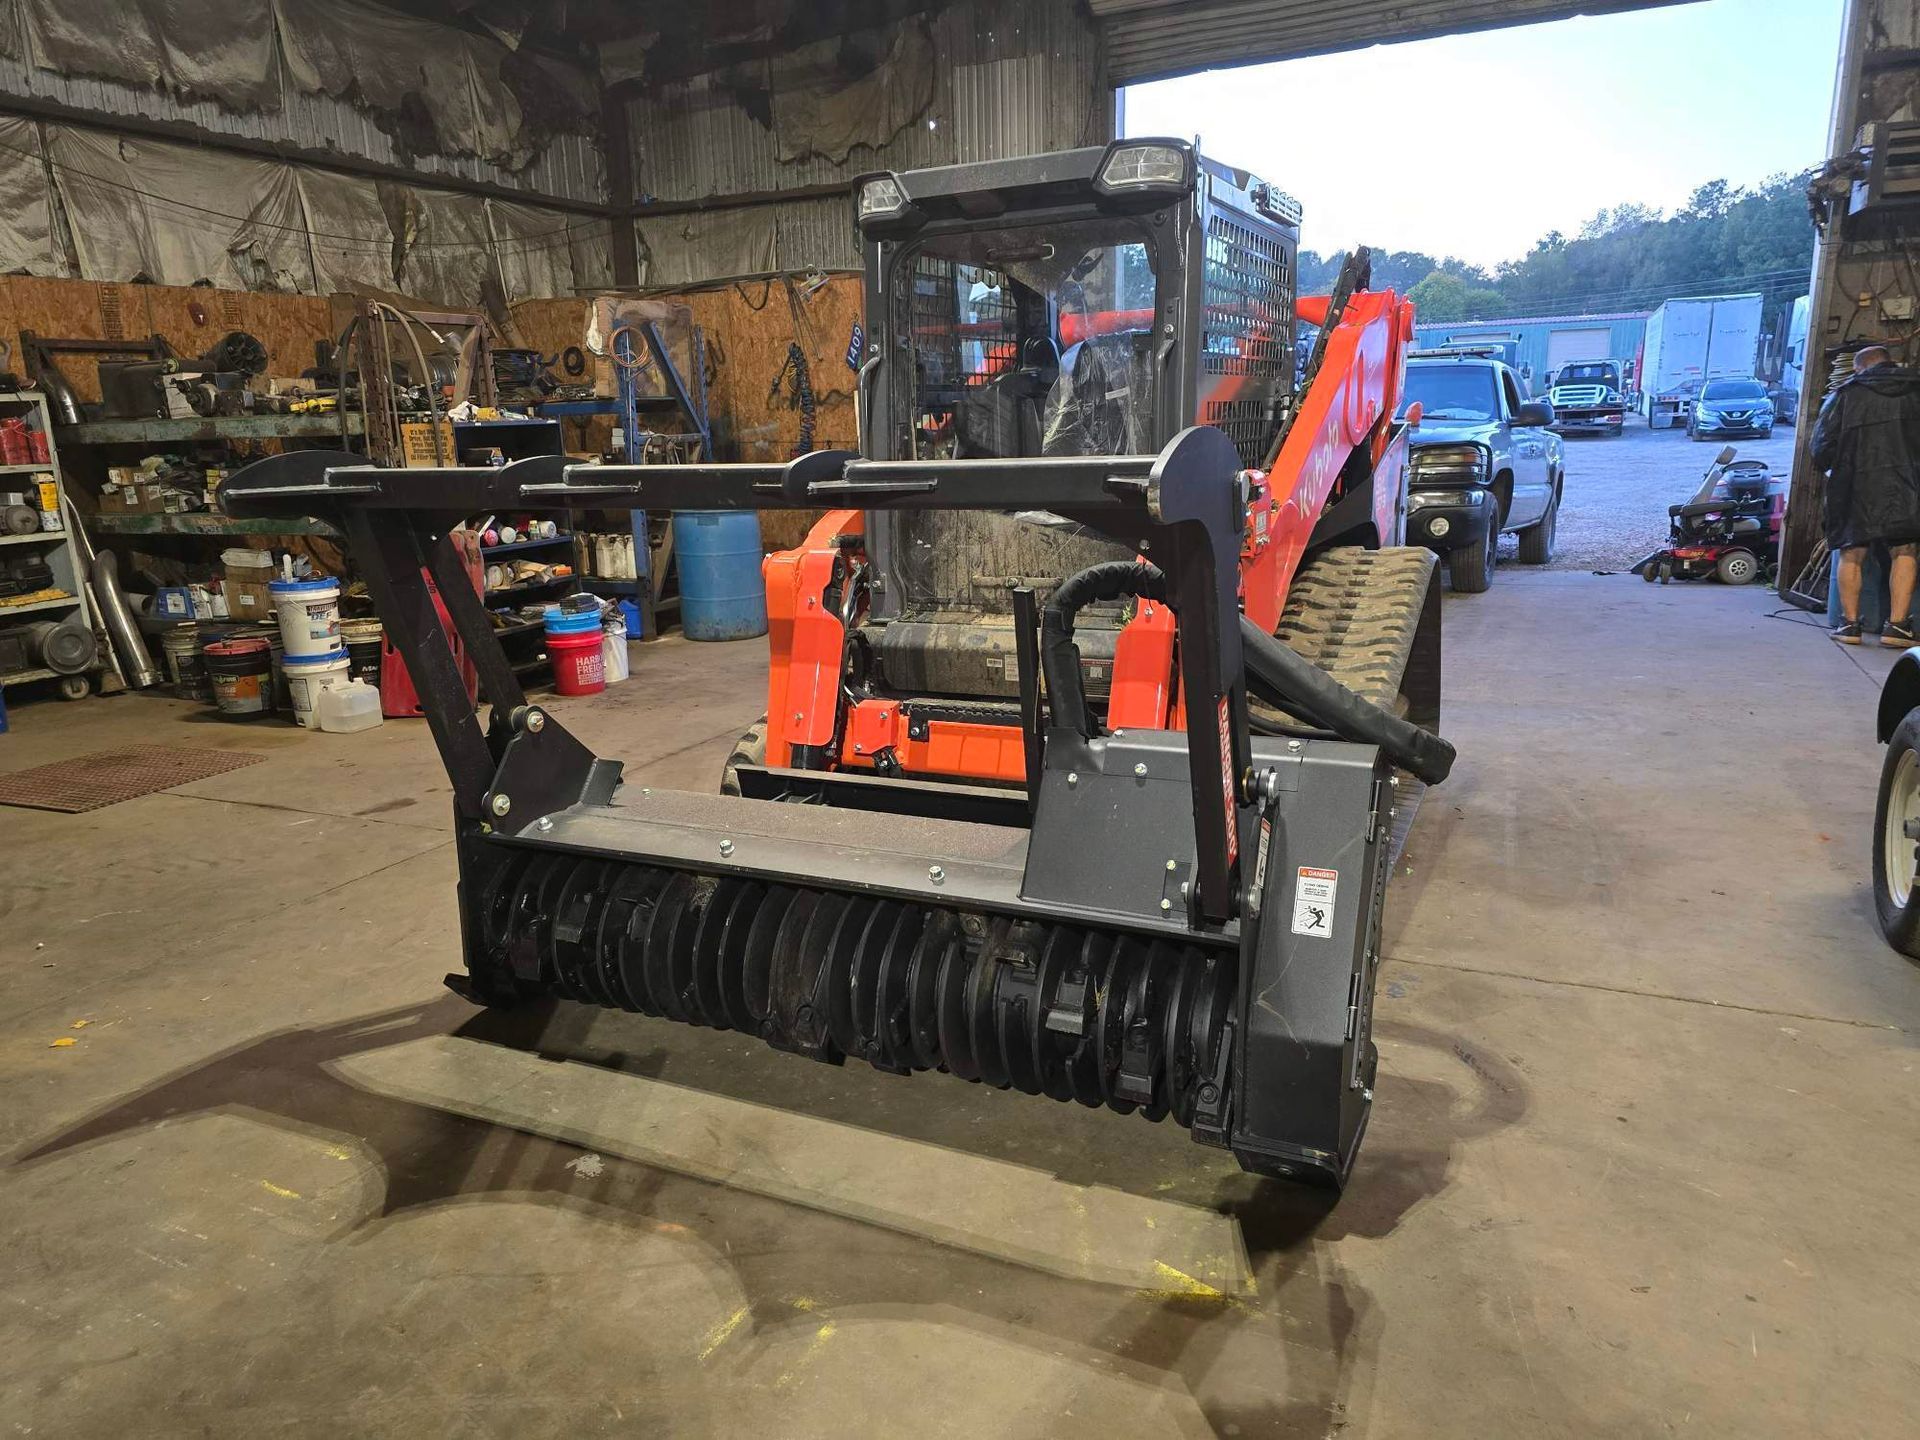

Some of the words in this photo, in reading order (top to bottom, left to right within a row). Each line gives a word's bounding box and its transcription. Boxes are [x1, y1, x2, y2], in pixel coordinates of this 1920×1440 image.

[848, 326, 862, 364] 1409
[1299, 420, 1339, 520] Kubota
[576, 654, 603, 666] HARB
[577, 663, 604, 675] FREIG
[1221, 701, 1233, 798] DANGER
[1308, 870, 1336, 879] DANGER
